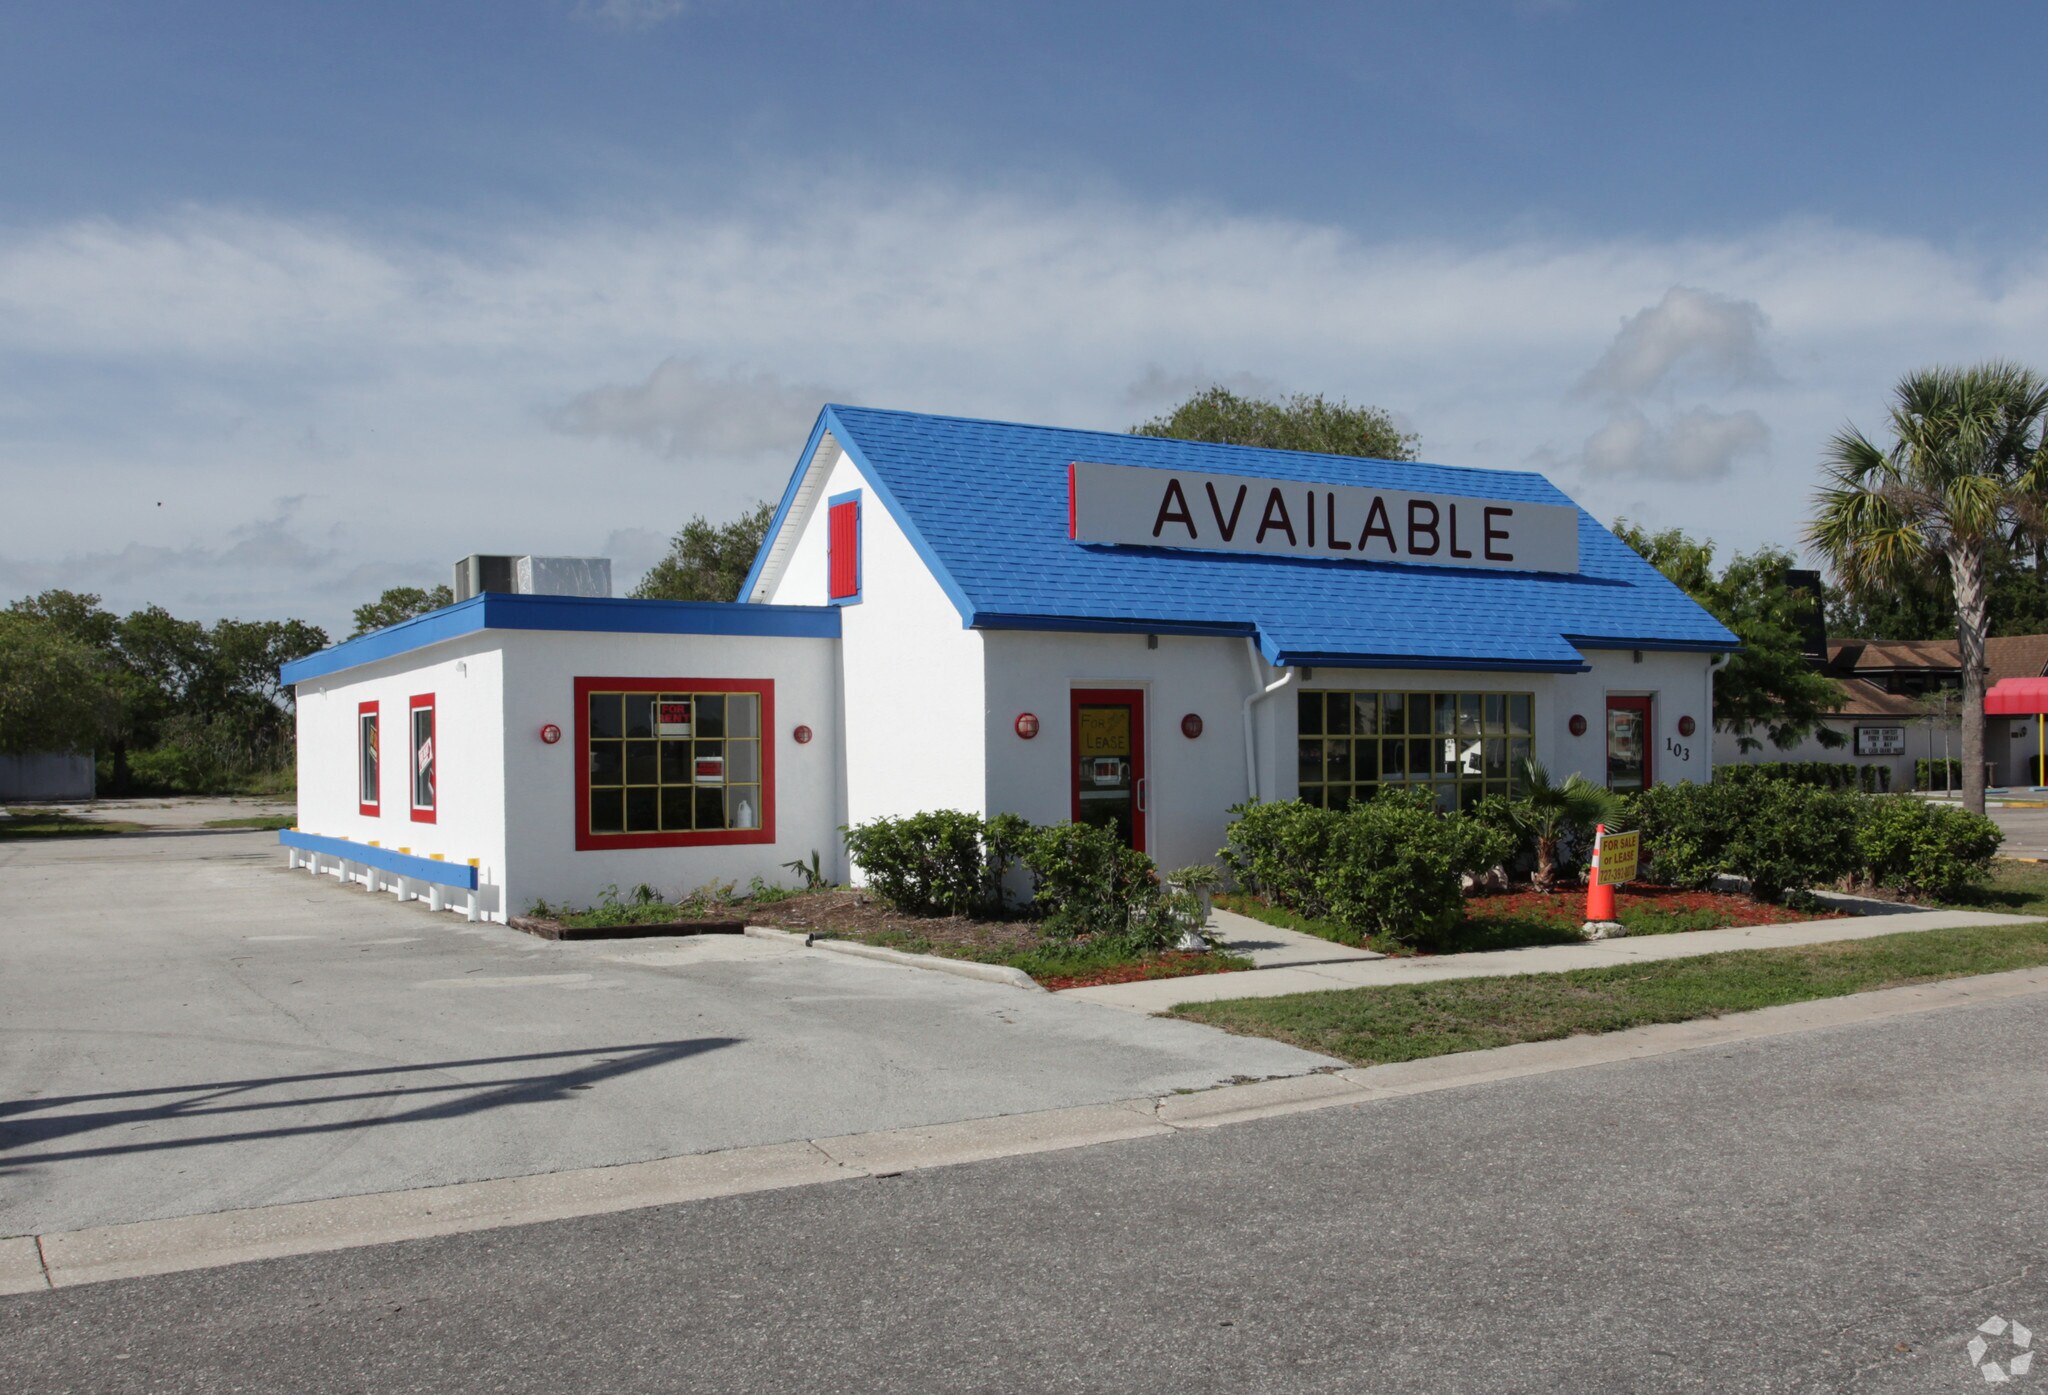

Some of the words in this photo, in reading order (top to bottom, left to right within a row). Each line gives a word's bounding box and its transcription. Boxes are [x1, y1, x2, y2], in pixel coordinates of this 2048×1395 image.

[1152, 478, 1514, 562] AVAILABLE
[662, 704, 685, 713] FOR
[1081, 713, 1105, 729] FOR
[1086, 732, 1125, 749] LEASE
[1666, 737, 1690, 762] 103
[1603, 839, 1619, 852] FOR
[1620, 836, 1636, 849] SALE
[1604, 856, 1613, 865] or
[1614, 850, 1634, 864] LEASE
